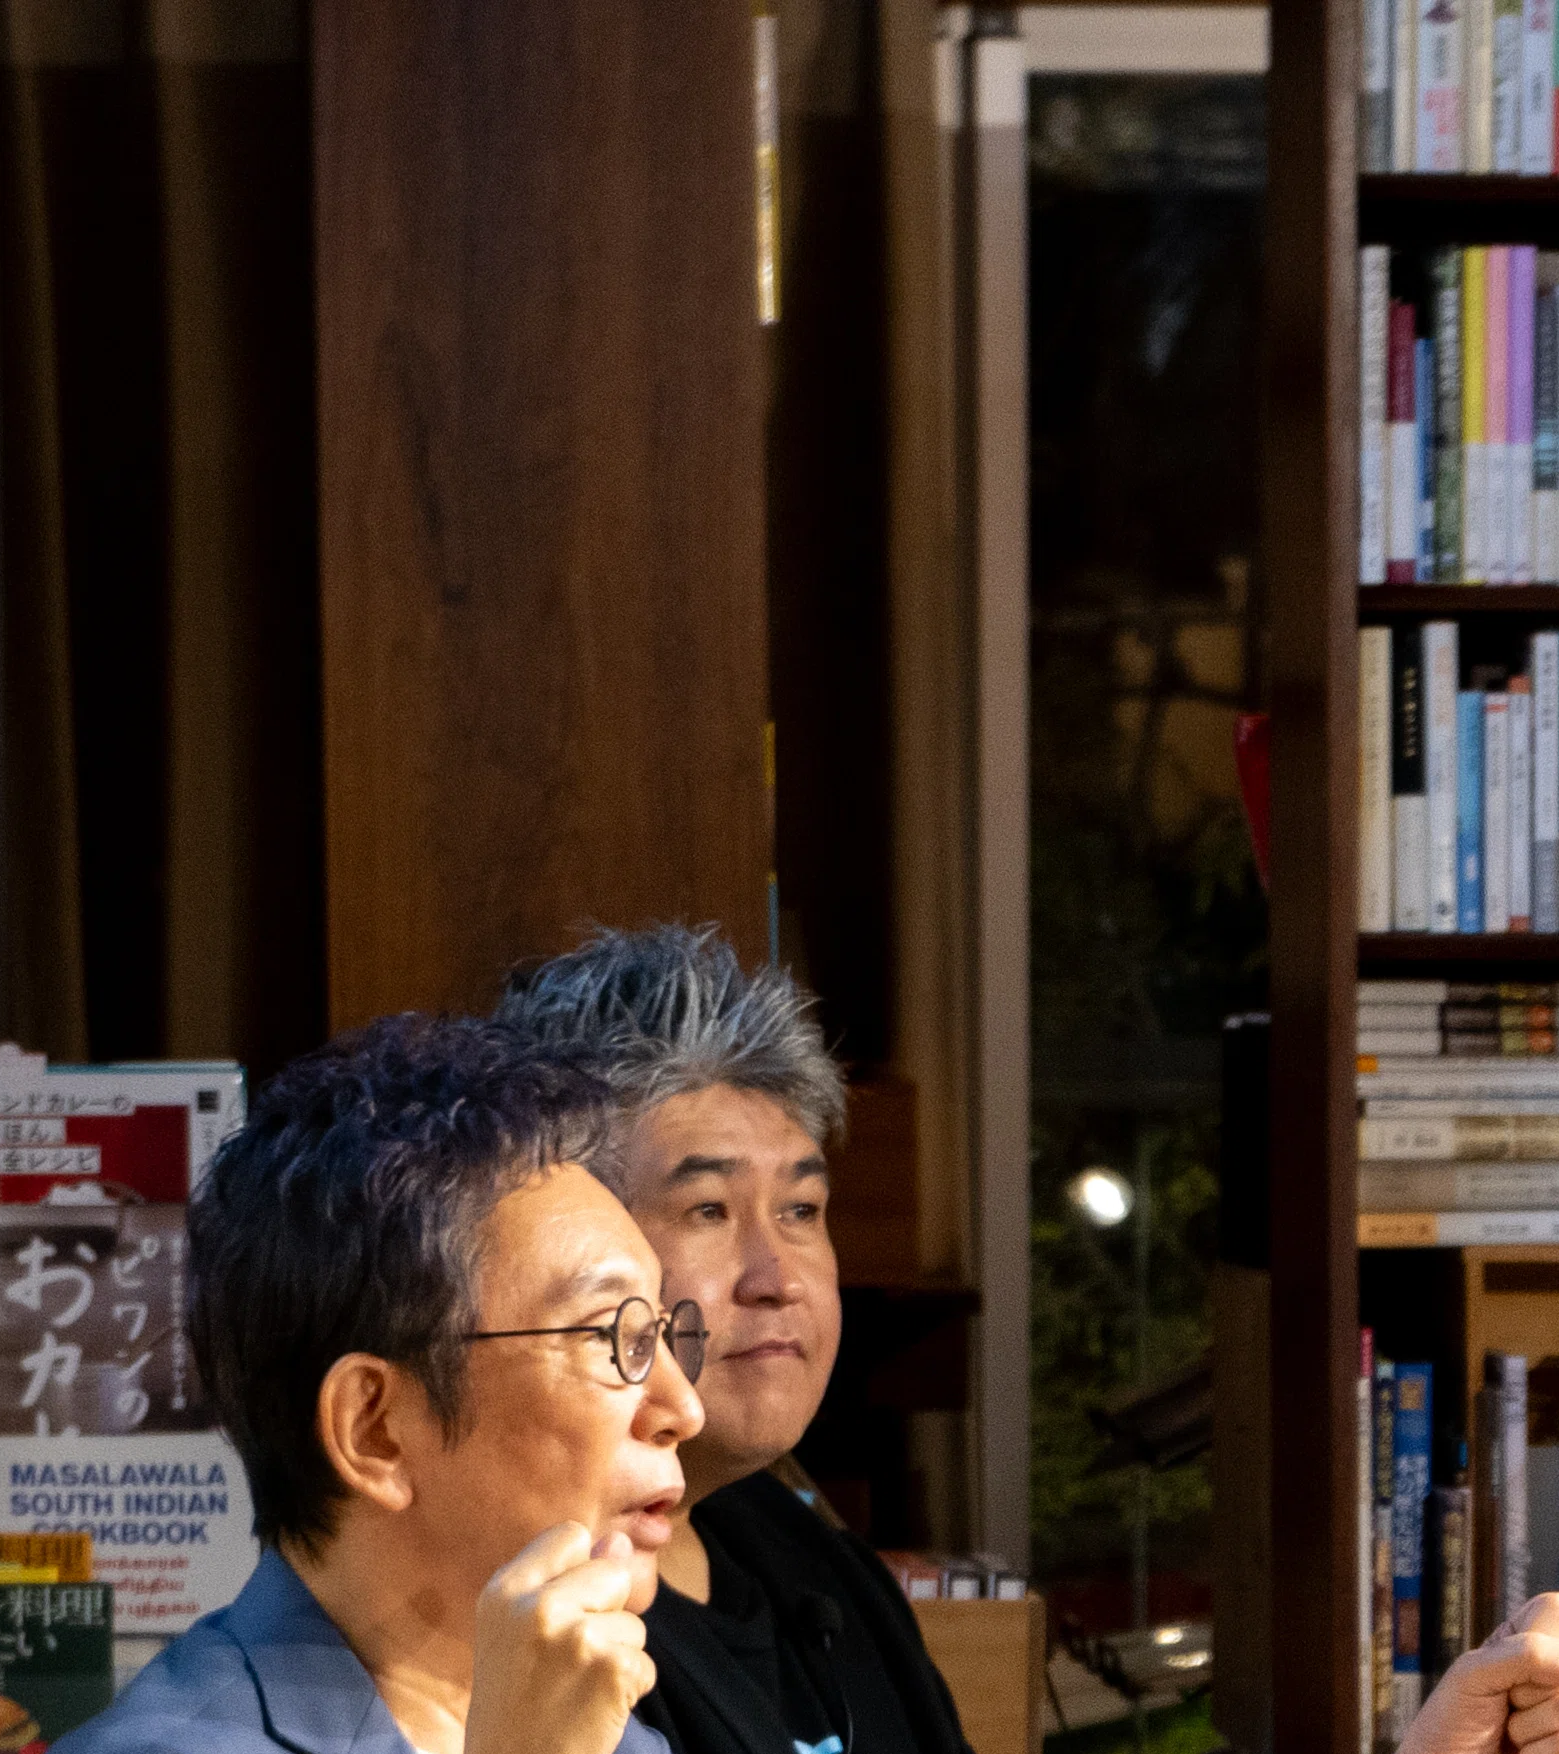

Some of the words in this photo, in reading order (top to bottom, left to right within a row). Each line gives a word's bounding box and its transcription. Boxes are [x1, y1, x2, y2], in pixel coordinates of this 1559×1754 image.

[110, 1236, 160, 1426] ピワンの
[10, 1463, 228, 1487] MASALAWALA
[10, 1492, 114, 1516] SOUTH
[124, 1491, 229, 1515] INDIAN
